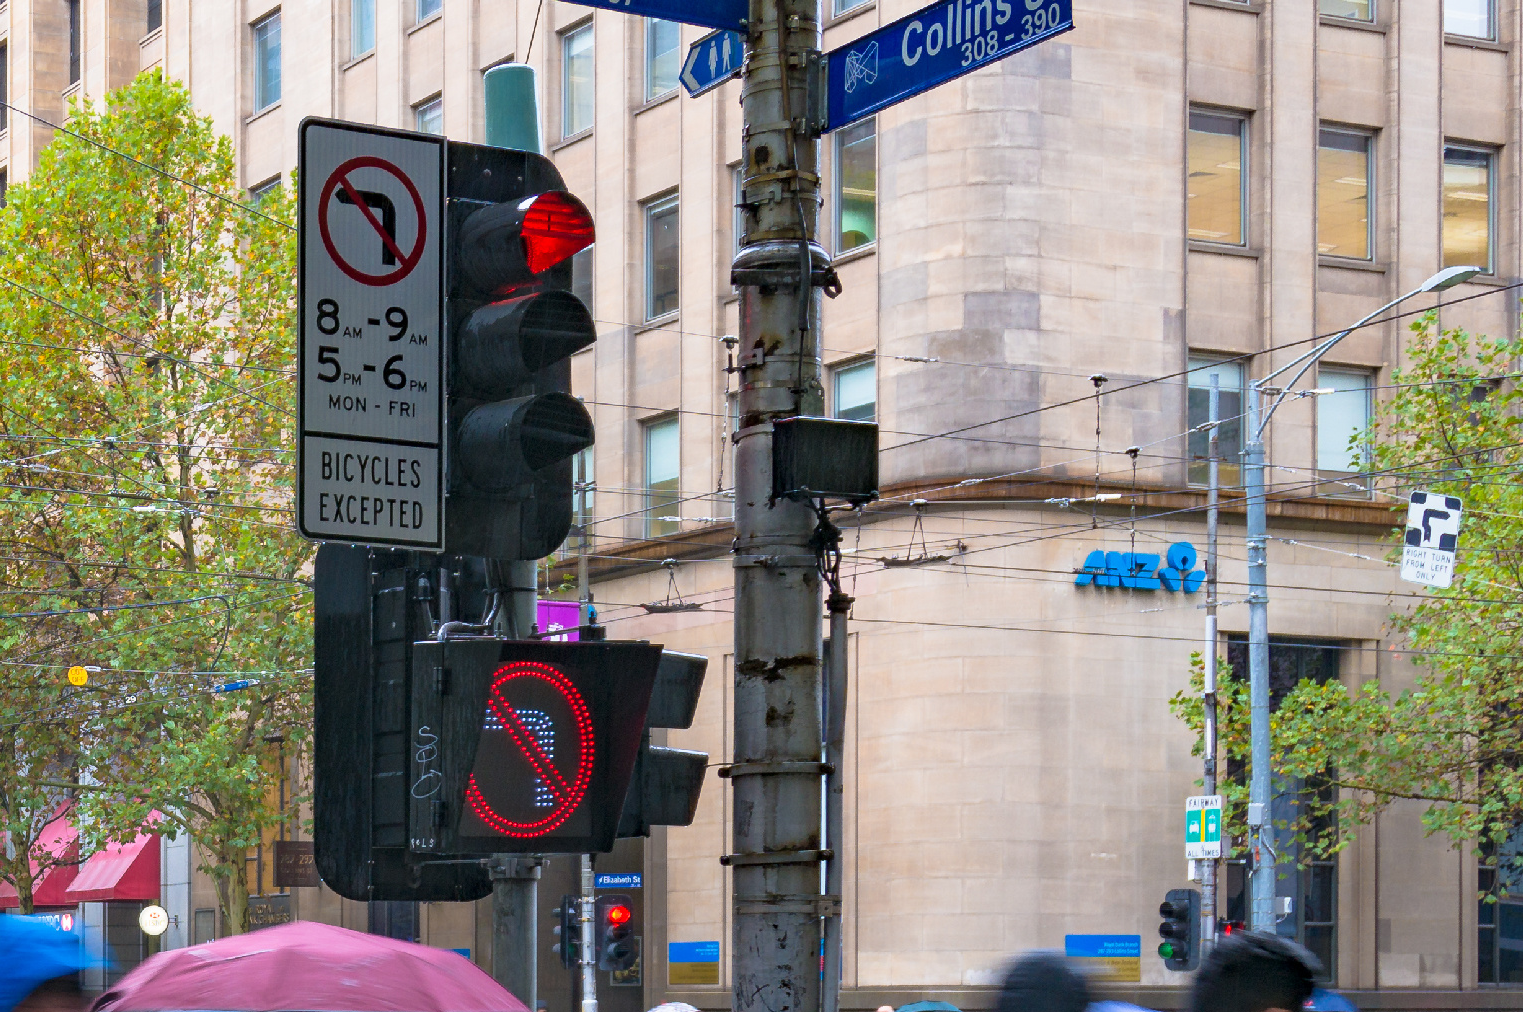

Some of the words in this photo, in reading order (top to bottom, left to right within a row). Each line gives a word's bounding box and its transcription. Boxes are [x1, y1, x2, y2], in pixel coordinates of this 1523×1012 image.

[902, 0, 1012, 67] Collins
[961, 30, 999, 67] 308
[1021, 3, 1061, 40] 390
[328, 393, 367, 413] MON
[389, 400, 415, 417] FRI
[321, 451, 421, 489] BICYCLES
[319, 492, 424, 529] EXCEPTED
[1406, 549, 1426, 559] RIGHT
[1432, 553, 1451, 564] TURN
[1406, 559, 1425, 569] FROM
[1431, 564, 1448, 573] LEFT
[1075, 549, 1160, 590] ANZ
[1416, 570, 1435, 580] ONLY
[1188, 798, 1219, 808] FAIRWAY
[1187, 850, 1199, 858] ALL
[1202, 849, 1220, 857] TIMES
[603, 875, 632, 884] Elizabeth
[632, 875, 641, 883] St
